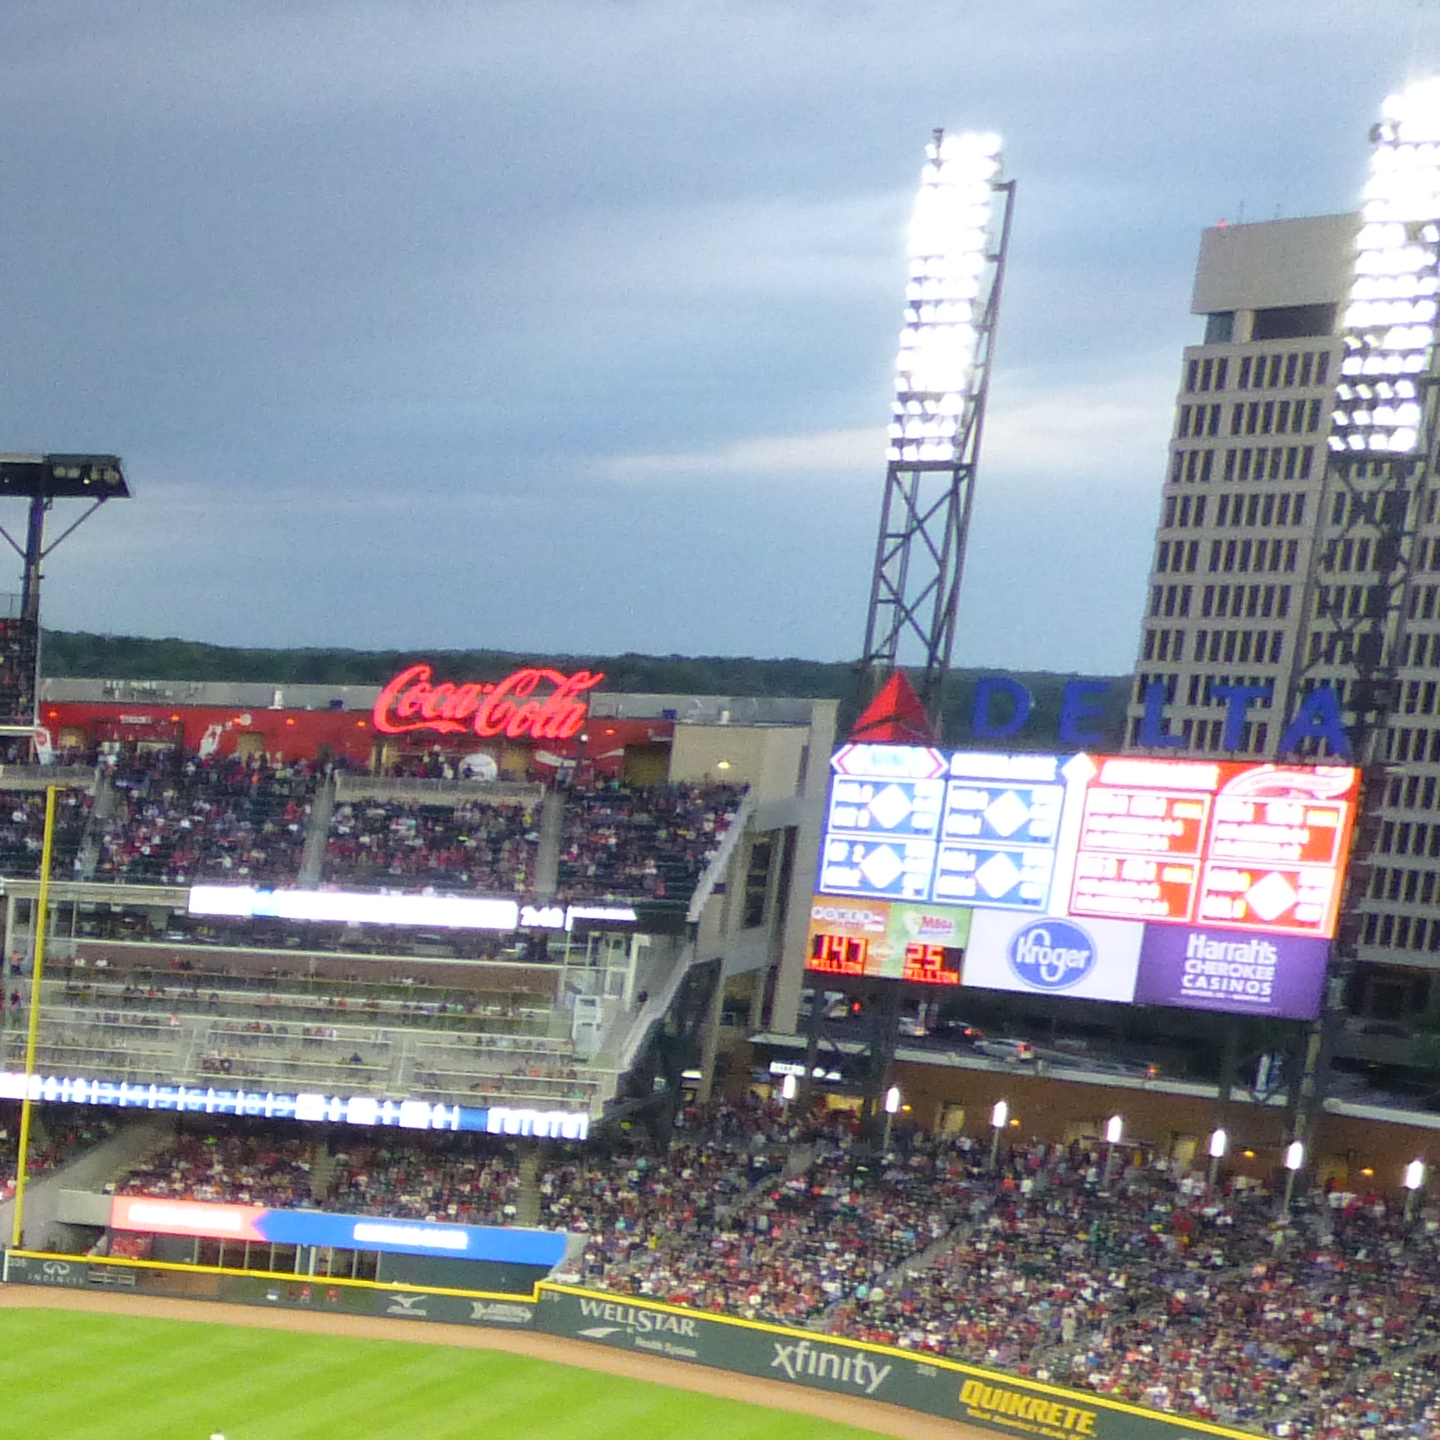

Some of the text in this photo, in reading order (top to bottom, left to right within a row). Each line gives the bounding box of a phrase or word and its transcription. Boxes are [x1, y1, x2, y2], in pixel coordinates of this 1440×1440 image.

[373, 661, 605, 739] Coca-Cola
[970, 676, 1351, 755] DELTA
[821, 934, 867, 963] 147
[906, 941, 945, 970] 25
[1015, 928, 1092, 983] Kroger
[1184, 959, 1276, 981] CHEROKEE
[1181, 974, 1272, 995] CASINOS
[580, 1298, 696, 1337] WELLSTAR
[771, 1341, 893, 1394] xfinity
[959, 1379, 1097, 1434] QUIKRETE
